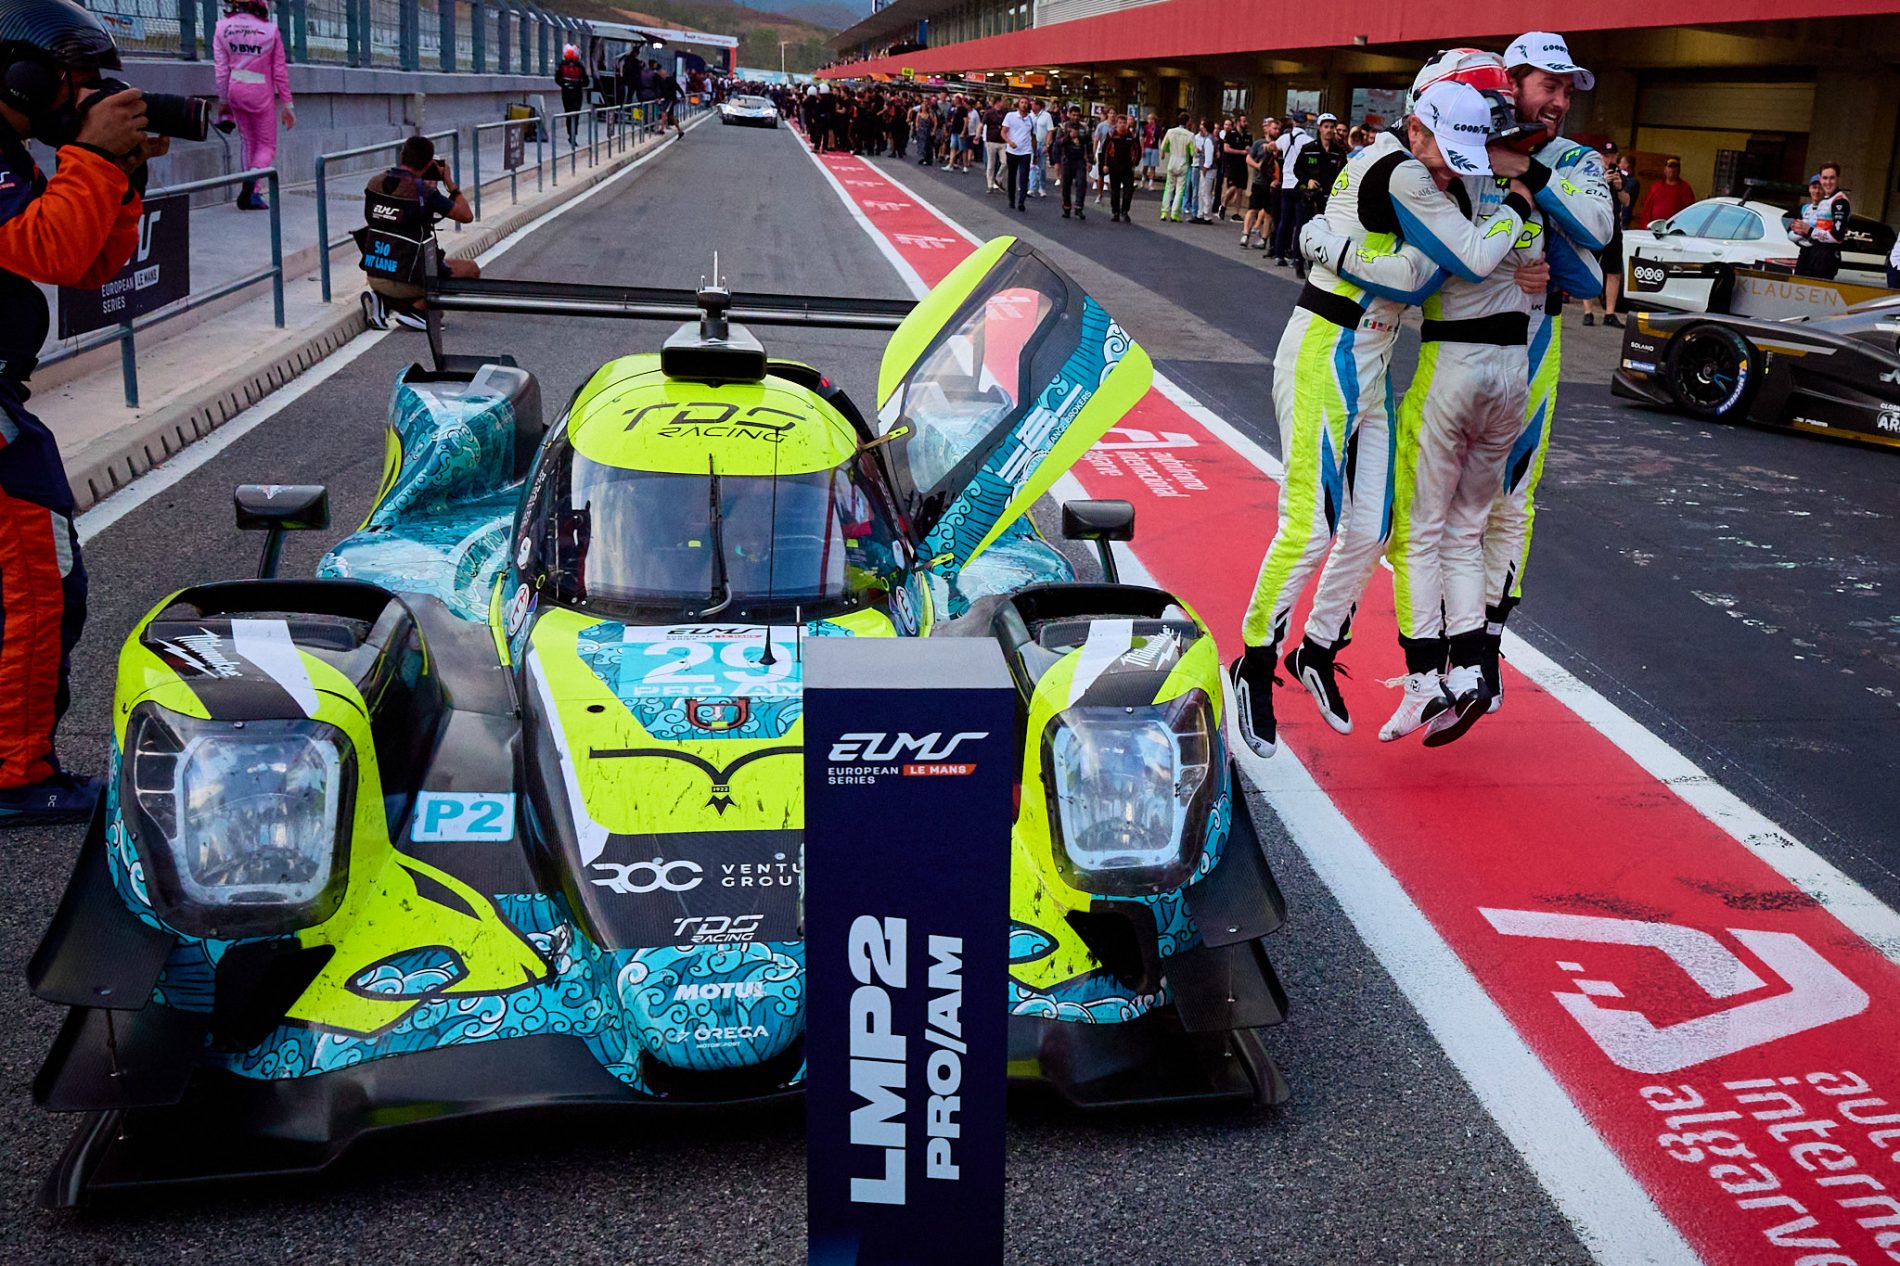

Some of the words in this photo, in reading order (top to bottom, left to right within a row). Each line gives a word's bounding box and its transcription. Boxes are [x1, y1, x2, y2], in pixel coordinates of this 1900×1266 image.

[239, 43, 263, 54] BWT
[375, 256, 398, 273] LANE
[101, 277, 135, 298] EUROPEAN
[136, 273, 144, 288] LE
[1737, 277, 1839, 306] KLAUSEN
[102, 295, 126, 315] SERIES
[1718, 377, 1745, 414] MICHELIN
[622, 402, 807, 432] TDS
[1063, 389, 1093, 424] BROKERS
[657, 426, 788, 443] RACING
[667, 627, 770, 635] ELMS
[642, 641, 794, 683] 29
[827, 732, 990, 761] ELMS
[827, 766, 899, 776] EUROPEAN
[910, 765, 926, 774] LE
[929, 765, 967, 774] MANS
[827, 775, 876, 785] SERIES
[423, 799, 505, 833] P2
[721, 874, 802, 887] GROU
[672, 914, 764, 937] TDS
[690, 932, 755, 943] RACING
[672, 981, 767, 1001] MOTUL
[694, 1024, 769, 1041] ORECA
[848, 914, 907, 1206] LMP2
[925, 934, 968, 1181] PRO/AM
